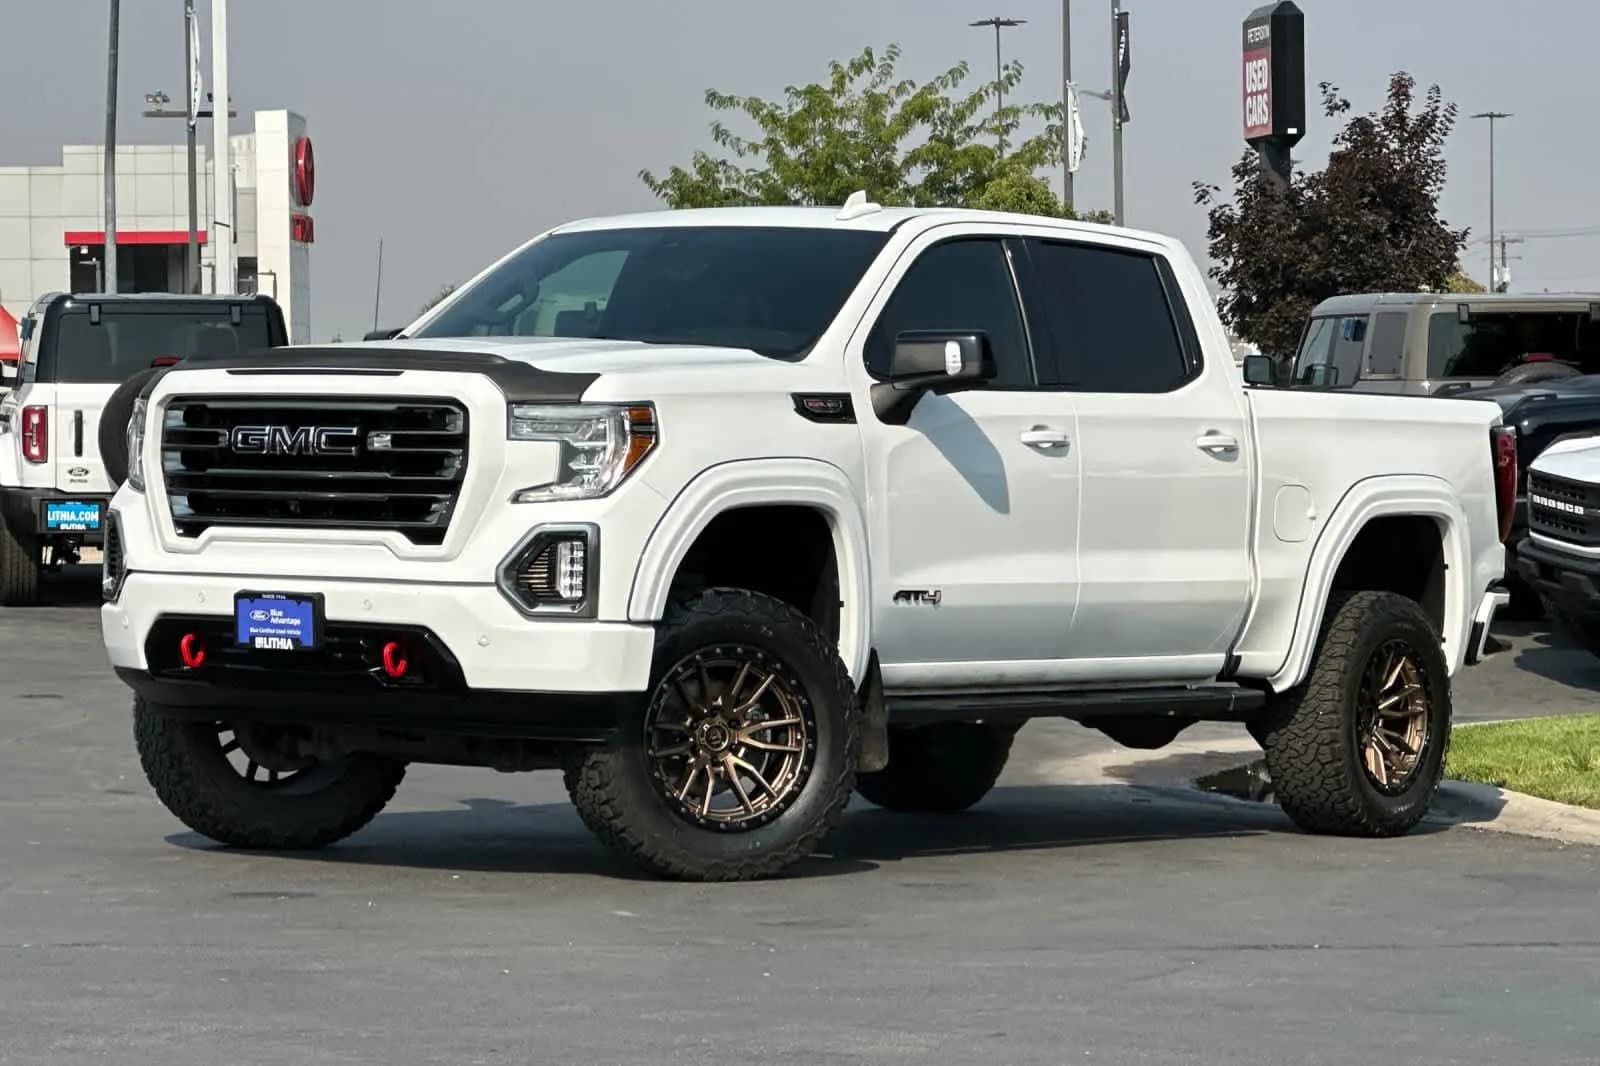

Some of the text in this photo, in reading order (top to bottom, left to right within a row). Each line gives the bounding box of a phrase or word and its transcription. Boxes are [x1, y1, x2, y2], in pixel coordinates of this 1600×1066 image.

[1246, 58, 1268, 93] USED
[1246, 93, 1268, 127] CARS
[232, 425, 358, 456] GMC
[47, 510, 99, 521] LITHIA.COM
[893, 590, 942, 605] AT4
[270, 617, 301, 626] Advantage
[264, 637, 293, 650] LITHIA
